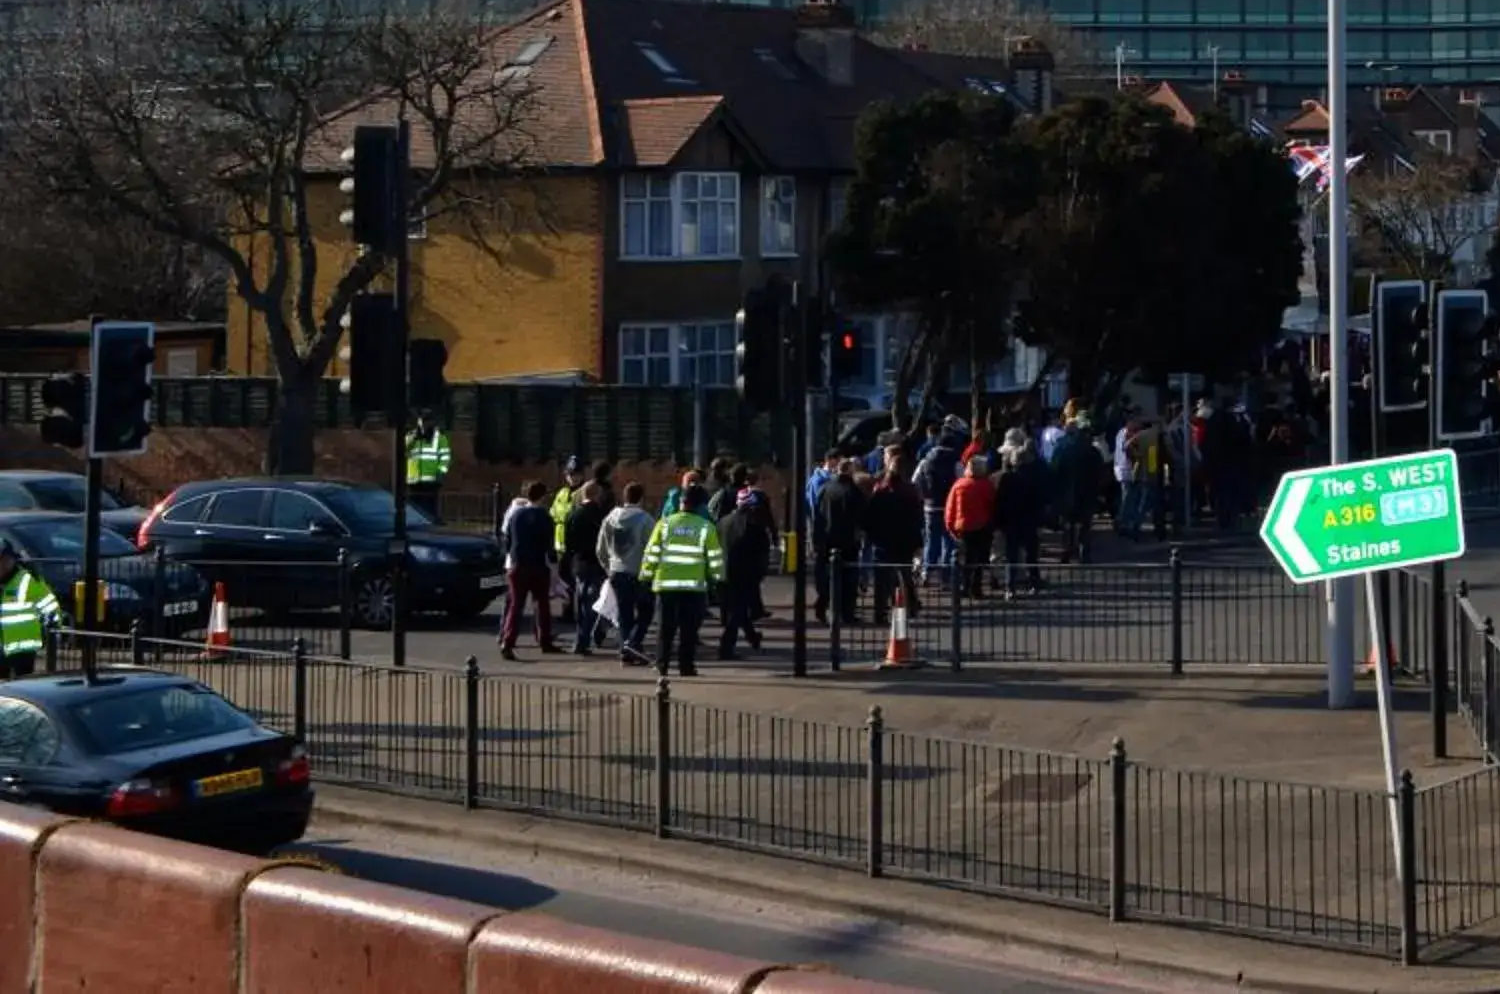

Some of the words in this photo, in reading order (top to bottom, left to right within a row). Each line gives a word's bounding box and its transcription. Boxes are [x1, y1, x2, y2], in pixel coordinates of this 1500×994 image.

[1321, 478, 1356, 499] The
[1361, 473, 1383, 493] S.
[1388, 461, 1448, 488] WEST
[1322, 503, 1377, 529] A316
[1326, 538, 1402, 566] Staines
